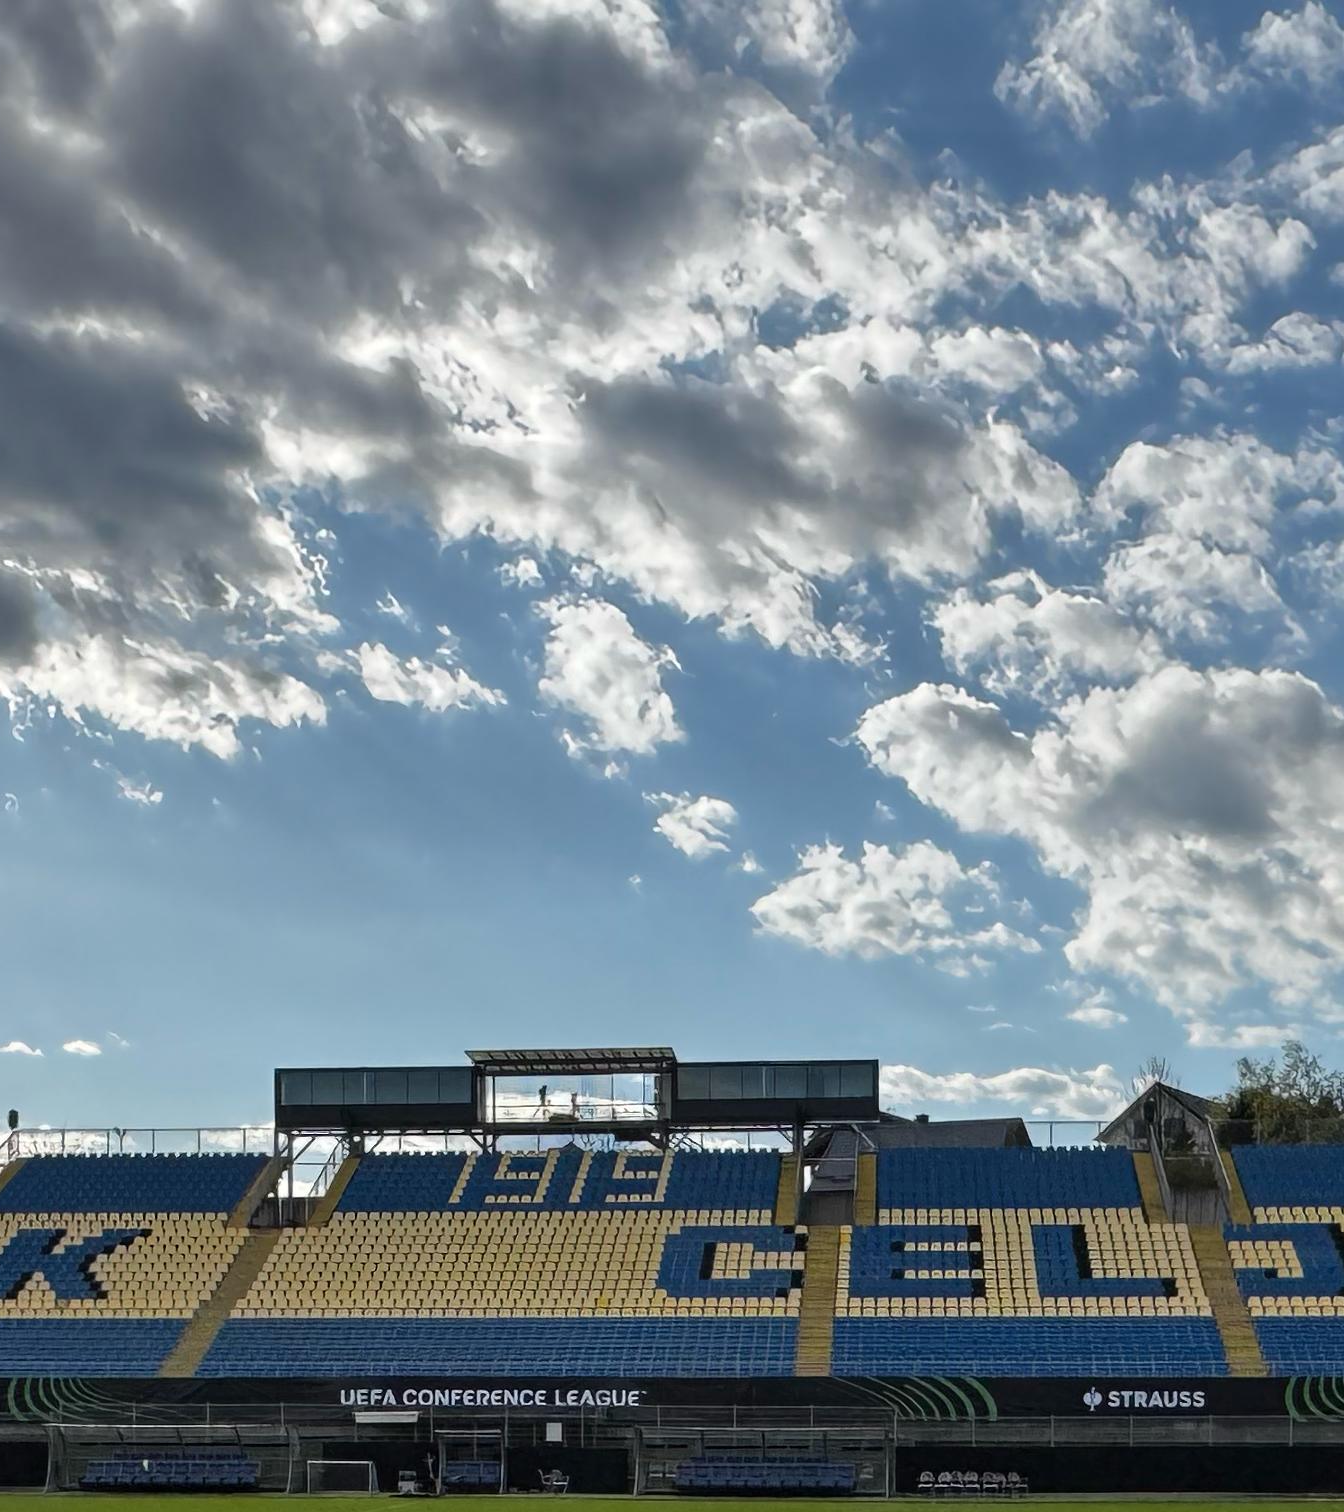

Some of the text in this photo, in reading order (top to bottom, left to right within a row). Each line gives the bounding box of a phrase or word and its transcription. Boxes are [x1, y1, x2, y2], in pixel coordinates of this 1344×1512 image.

[448, 1149, 675, 1204] 1919
[340, 1389, 641, 1407] UEFA CONFERENCE LEAGUE
[1107, 1390, 1206, 1408] STRAUSS
